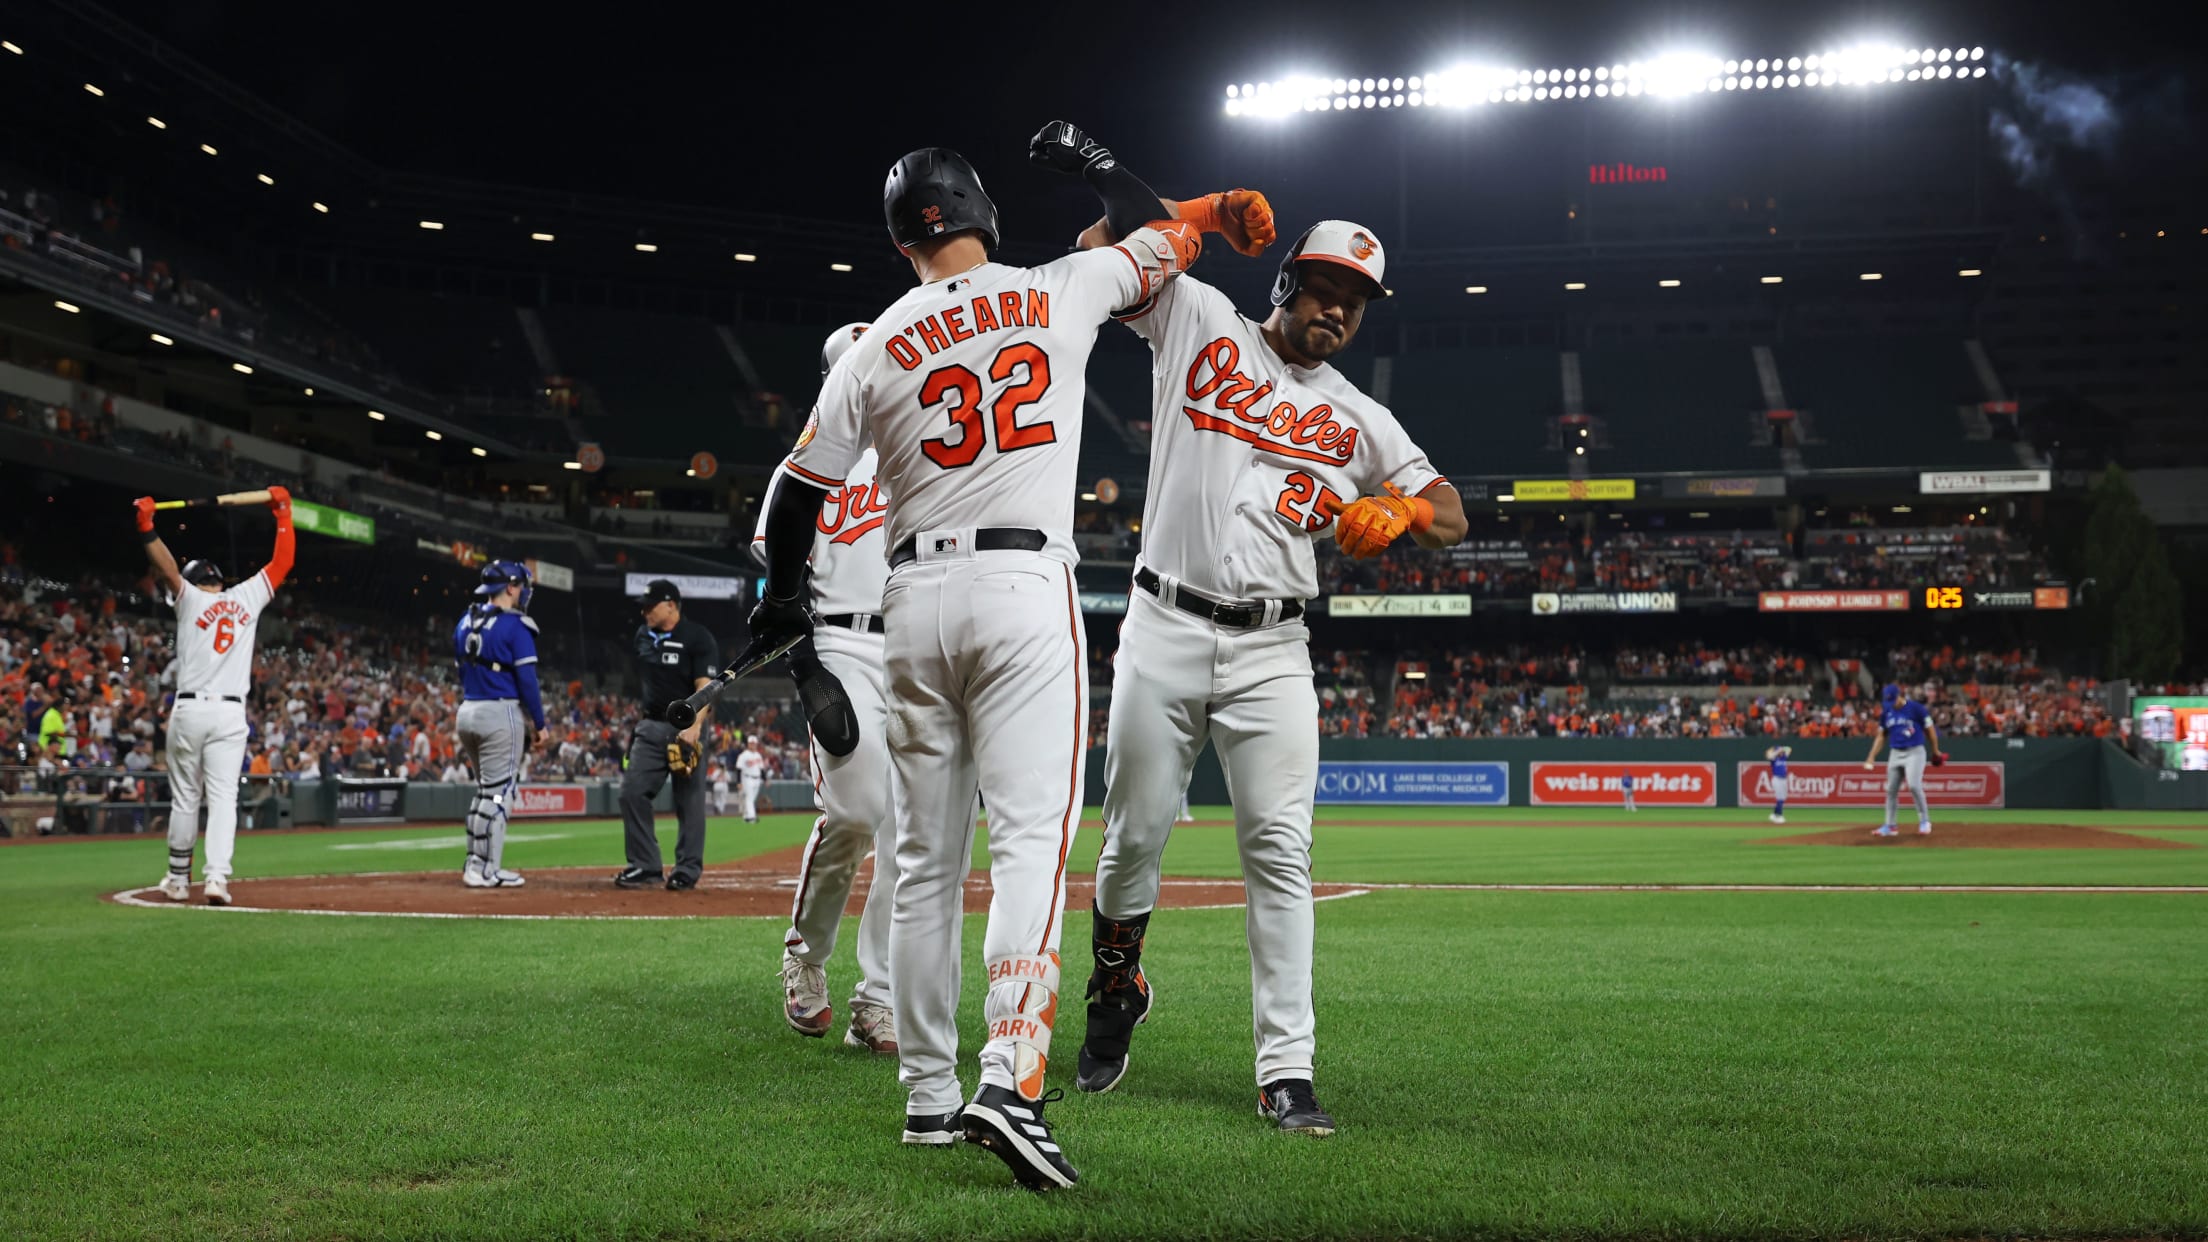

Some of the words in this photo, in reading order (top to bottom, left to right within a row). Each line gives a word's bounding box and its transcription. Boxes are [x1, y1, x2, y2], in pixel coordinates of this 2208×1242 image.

[1590, 162, 1667, 183] Hilton
[922, 205, 941, 223] 32
[886, 288, 1049, 371] O'HEARN
[918, 341, 1057, 470] 32
[1186, 336, 1359, 457] Orioles
[1275, 471, 1342, 532] 25
[1618, 592, 1675, 609] UNION
[1926, 587, 1963, 608] 0:25
[213, 616, 234, 654] 6
[1393, 773, 1414, 782] LAKE
[1437, 773, 1472, 782] COLLEGE
[1475, 773, 1487, 782] OF
[1545, 772, 1599, 791] weis
[1452, 784, 1493, 793] MEDICINE
